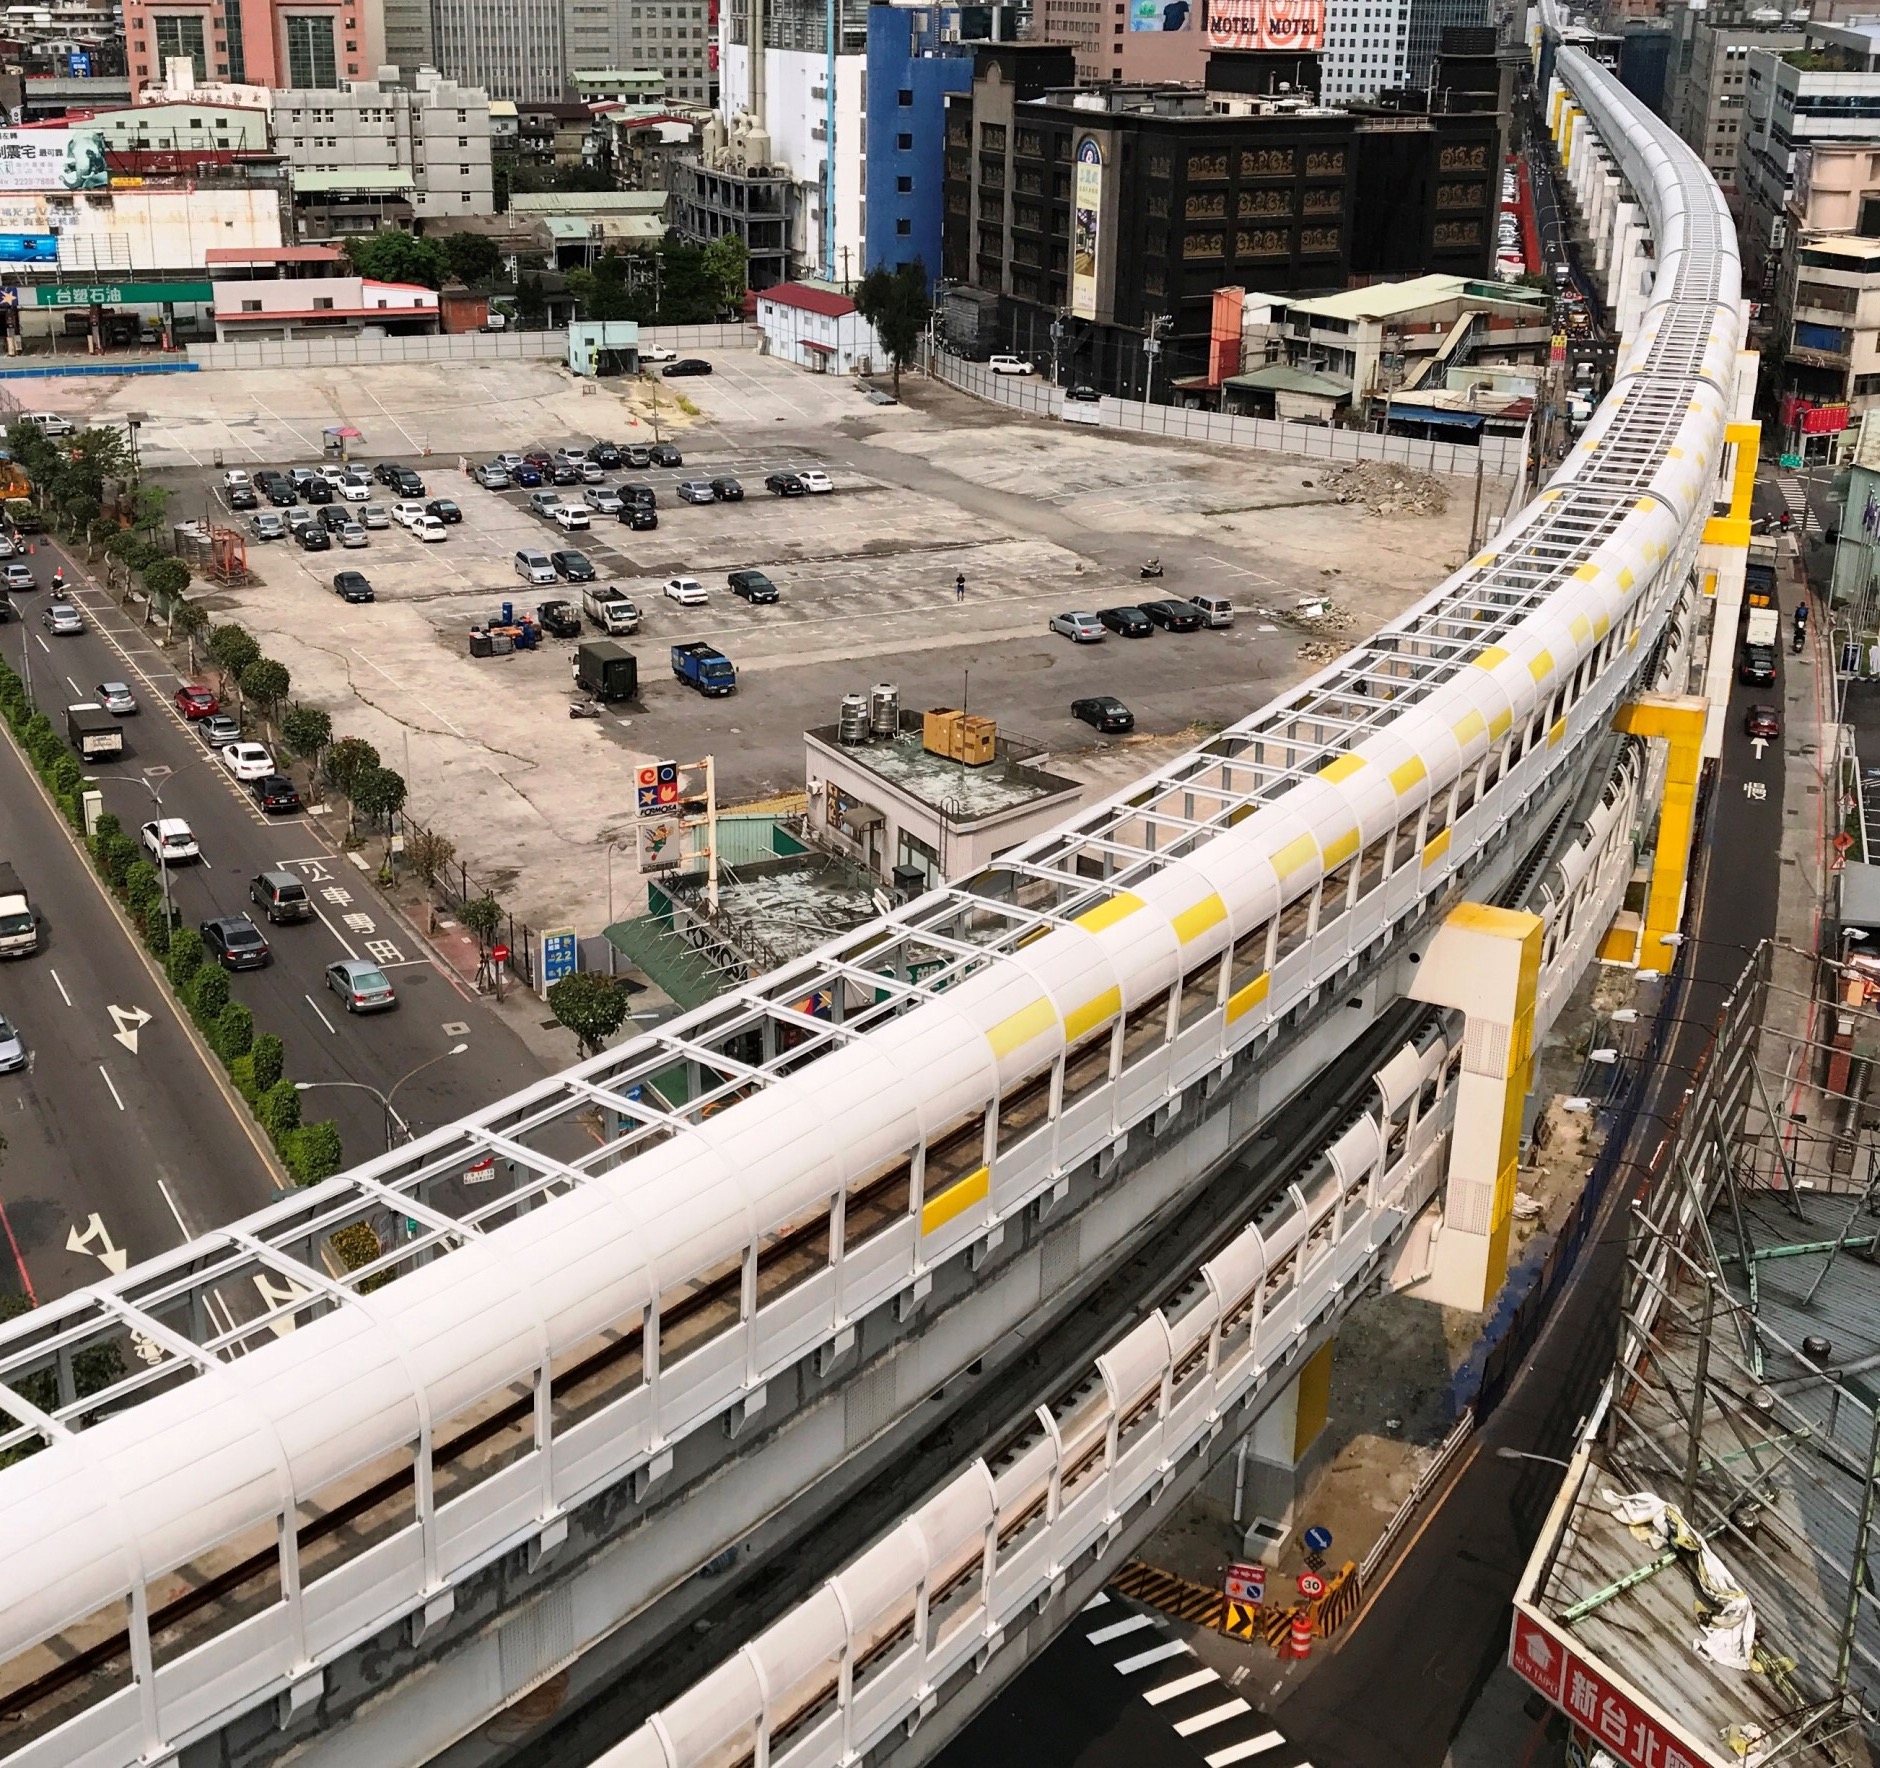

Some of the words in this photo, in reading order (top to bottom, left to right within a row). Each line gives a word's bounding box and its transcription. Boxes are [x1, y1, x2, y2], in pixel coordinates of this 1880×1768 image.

[1211, 16, 1258, 34] MOTEL
[1269, 18, 1318, 35] MOTEL
[56, 287, 121, 302] 台塑石油
[1743, 782, 1766, 800] 慢
[640, 804, 677, 816] FORMOSA
[298, 861, 405, 963] 公車專用
[1304, 1579, 1320, 1591] 30
[1515, 1653, 1532, 1672] NEW
[1534, 1669, 1558, 1694] TAIPEI
